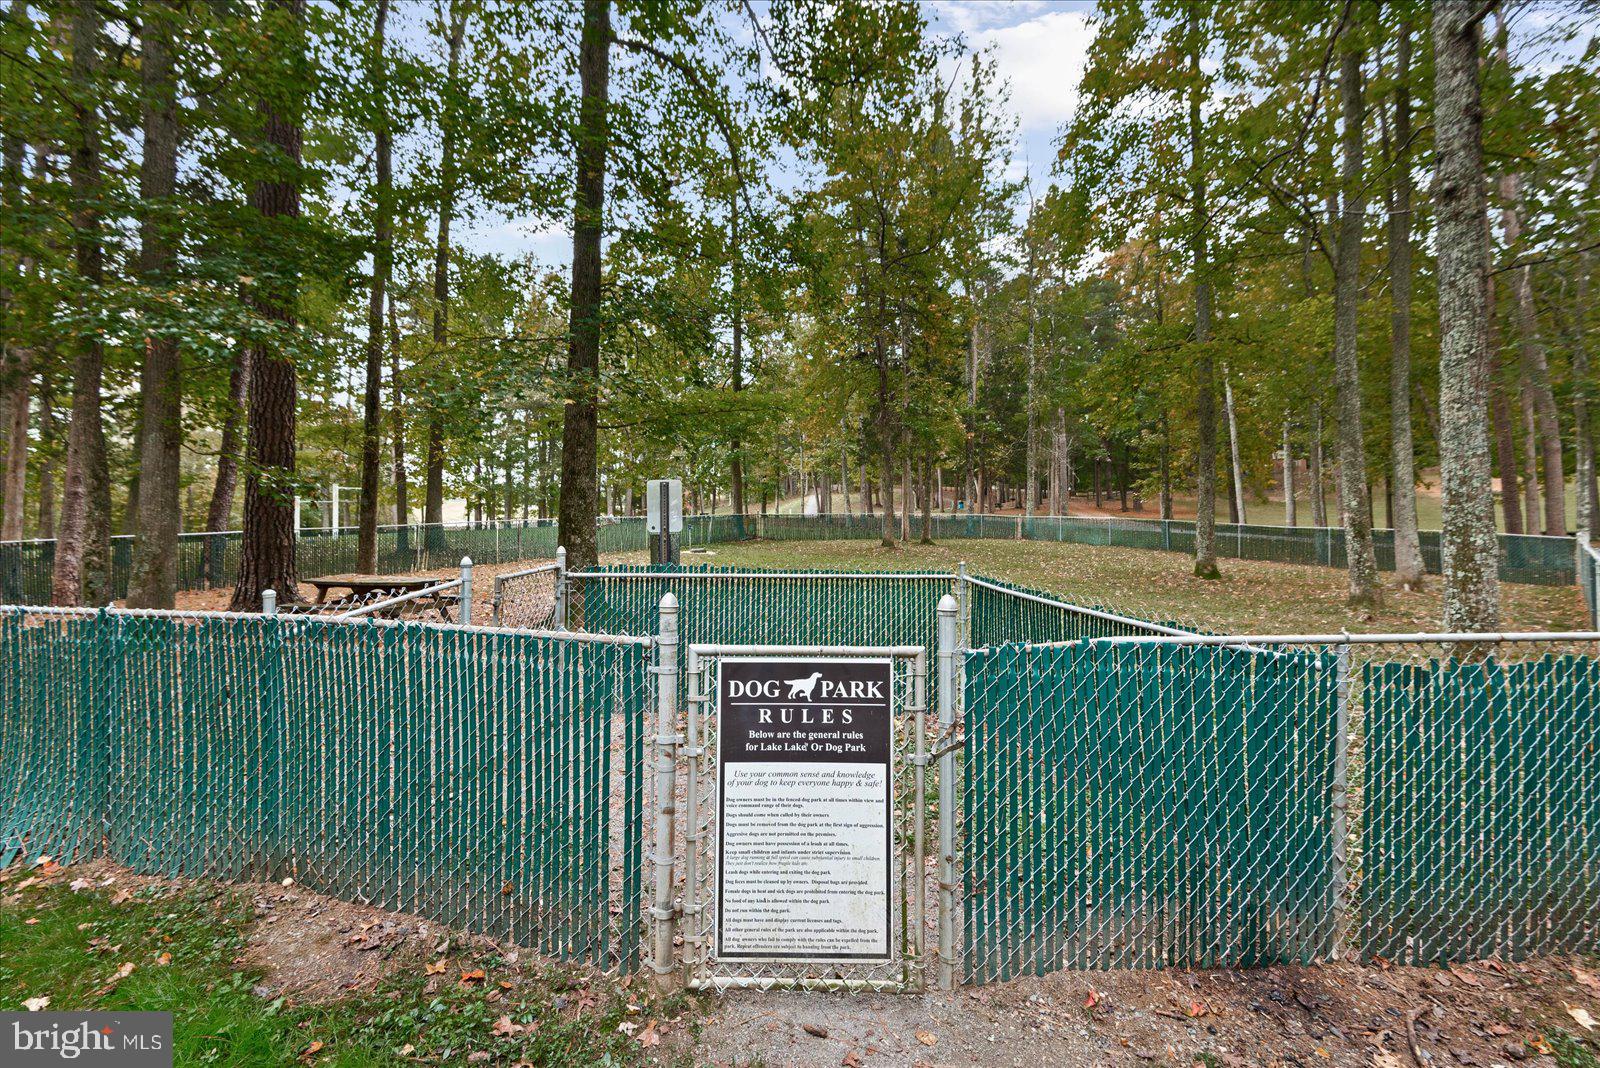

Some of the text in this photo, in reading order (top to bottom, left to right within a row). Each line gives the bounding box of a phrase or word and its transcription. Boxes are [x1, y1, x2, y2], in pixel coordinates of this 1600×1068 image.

[728, 680, 884, 698] DOG PARK
[759, 709, 853, 724] RULES
[808, 731, 840, 740] general
[746, 743, 758, 751] for
[761, 743, 782, 751] Lake
[826, 744, 842, 753] Dog
[845, 744, 866, 752] Park
[837, 771, 876, 780] knowledge
[727, 779, 735, 788] of
[755, 779, 768, 788] dog
[779, 779, 796, 788] keep
[832, 780, 854, 788] happy
[865, 780, 882, 789] safe!
